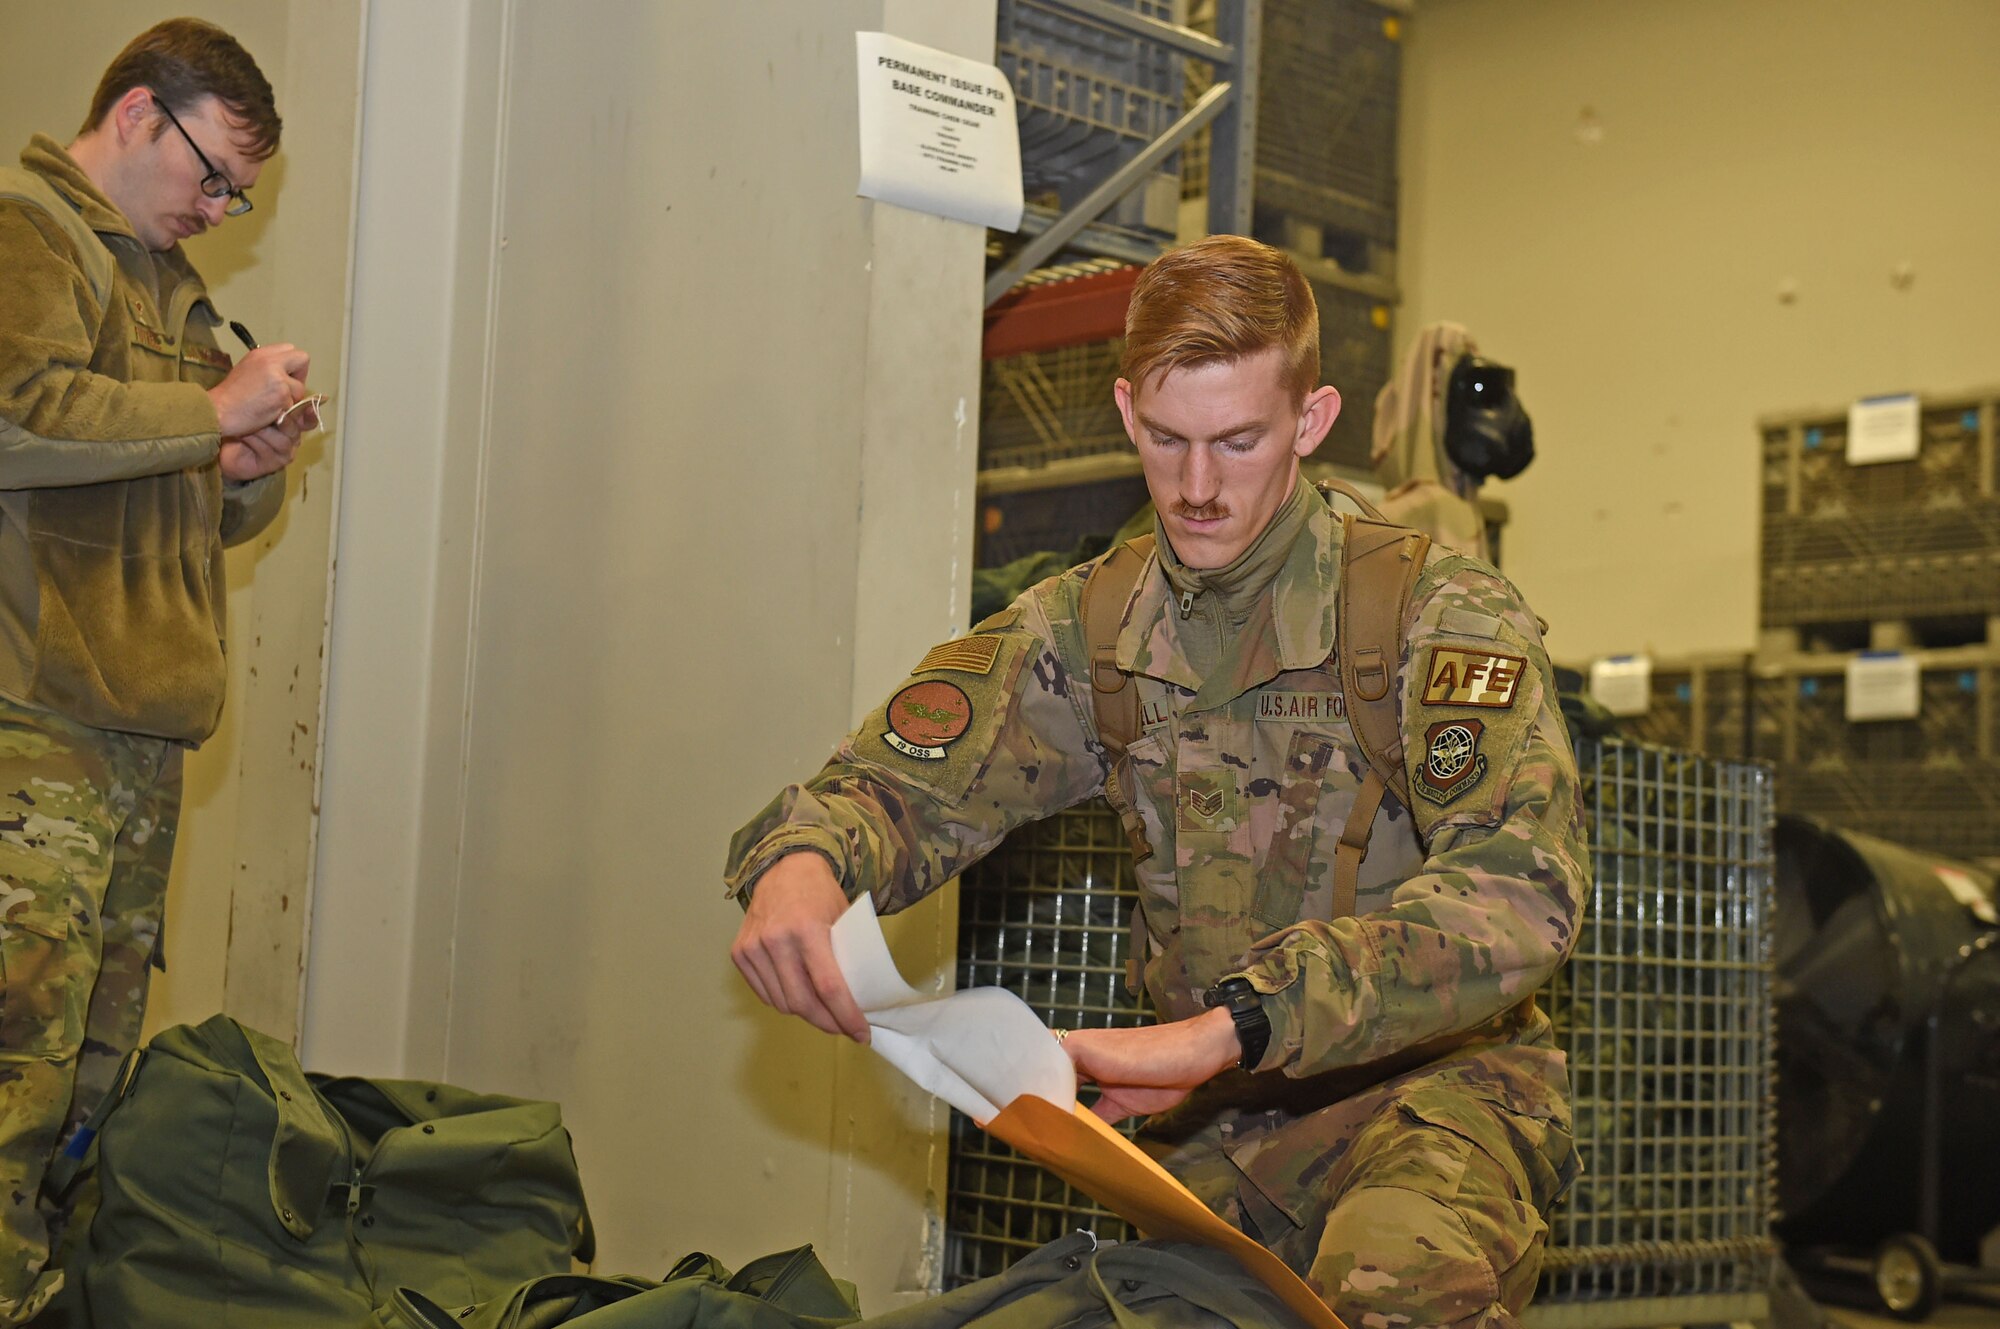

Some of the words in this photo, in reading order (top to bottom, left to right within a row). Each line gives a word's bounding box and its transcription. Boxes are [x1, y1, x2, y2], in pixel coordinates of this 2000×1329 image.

[878, 56, 947, 85] PERMANENT
[950, 77, 983, 95] ISSUE
[892, 79, 922, 97] BASE
[924, 89, 996, 116] COMMANDER
[1433, 661, 1518, 692] AFE
[896, 740, 906, 750] 19
[909, 747, 930, 758] OSS
[1449, 771, 1480, 796] COMMAND
